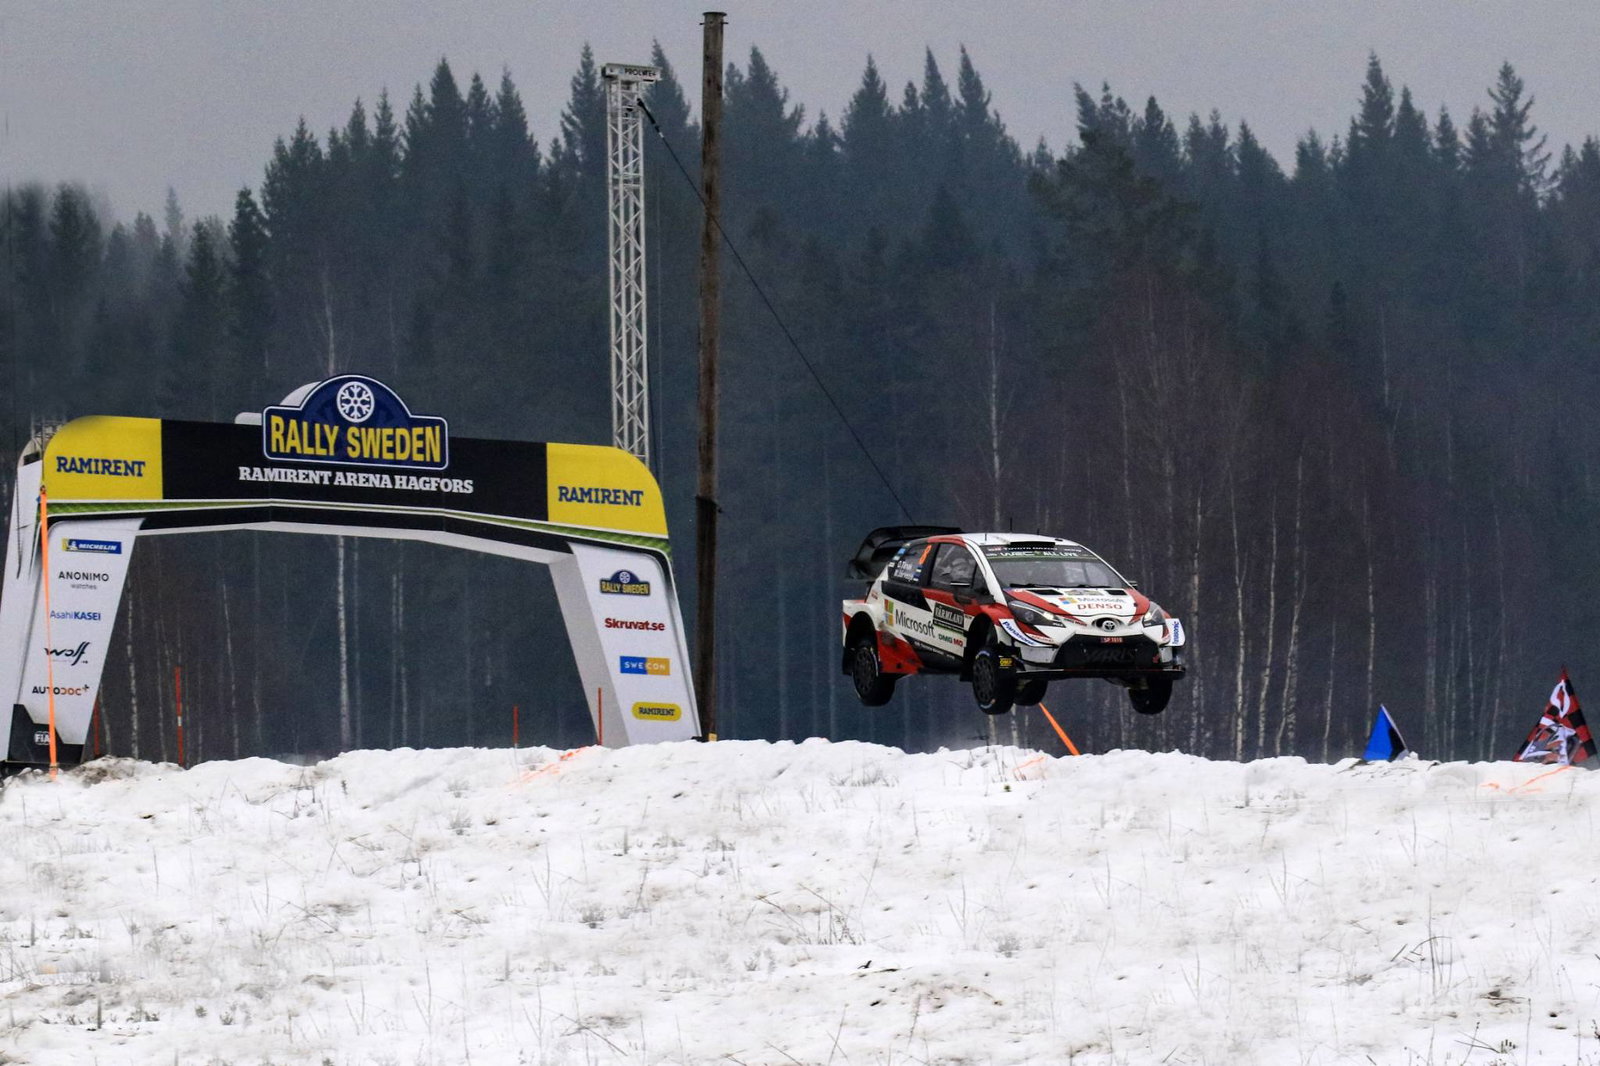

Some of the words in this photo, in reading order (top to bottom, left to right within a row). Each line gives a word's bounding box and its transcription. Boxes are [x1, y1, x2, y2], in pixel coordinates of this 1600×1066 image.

[270, 415, 339, 456] RALLY
[347, 425, 441, 463] SWEDEN
[56, 456, 146, 478] RAMIRENT
[238, 466, 333, 485] RAMIRENT
[334, 470, 393, 489] ARENA
[394, 475, 474, 494] HAGFORS
[558, 486, 644, 506] RAMIRENT
[58, 571, 110, 581] ANONIMO
[601, 581, 621, 592] RALLY
[622, 583, 649, 594] SWEDEN
[604, 618, 665, 631] Skruvat.se
[895, 609, 935, 639] Microsoft
[624, 661, 666, 670] SWECON
[638, 706, 675, 717] RAMIRENT
